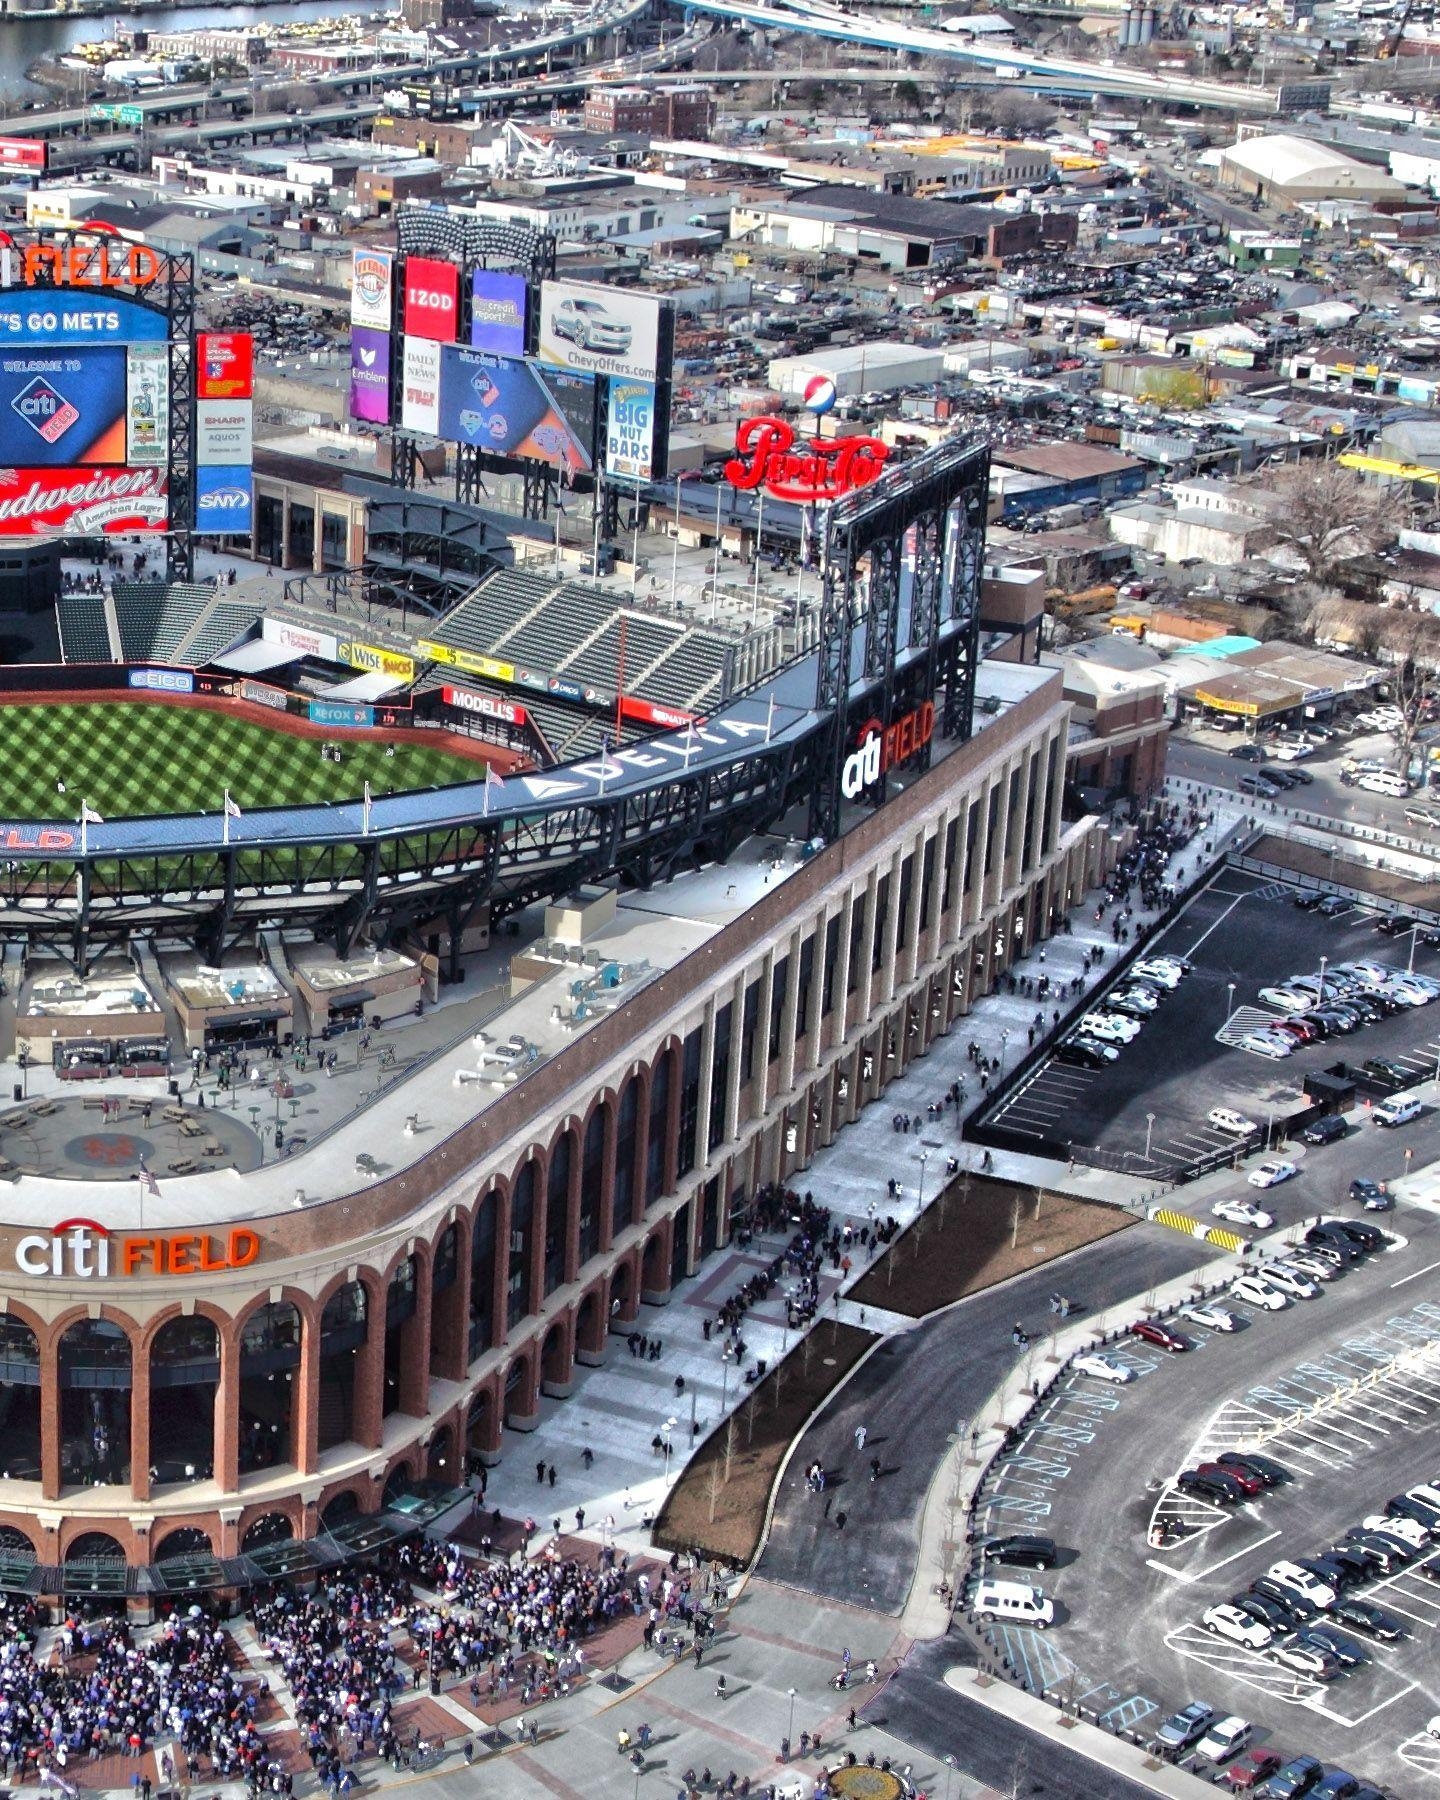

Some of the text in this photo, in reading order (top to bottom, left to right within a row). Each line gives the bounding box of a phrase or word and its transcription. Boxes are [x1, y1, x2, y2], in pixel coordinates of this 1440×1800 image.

[25, 244, 160, 286] FIELD
[410, 288, 452, 309] IZOD
[27, 313, 57, 331] GO
[63, 312, 120, 330] METS
[3, 360, 81, 372] WELCOME TO
[407, 352, 436, 365] DAILY
[568, 351, 654, 377] ChevyOffers.com
[352, 366, 387, 385] Emblem
[407, 366, 436, 379] NEWS
[21, 394, 55, 415] citi
[158, 363, 166, 442] SALES
[45, 409, 73, 436] FIELD
[205, 417, 245, 425] SHARP
[615, 402, 648, 428] BIG
[620, 427, 642, 440] NUT
[610, 438, 649, 462] BARS
[200, 492, 241, 508] SNY
[85, 505, 132, 525] American
[133, 501, 163, 513] Lager
[353, 648, 380, 669] WISE
[131, 672, 190, 690] GEICO
[315, 707, 350, 719] xerox
[453, 690, 515, 723] MODELL'S
[882, 701, 935, 772] FIELD
[570, 717, 770, 781] DELTA
[15, 1227, 259, 1277] citi FIELD
